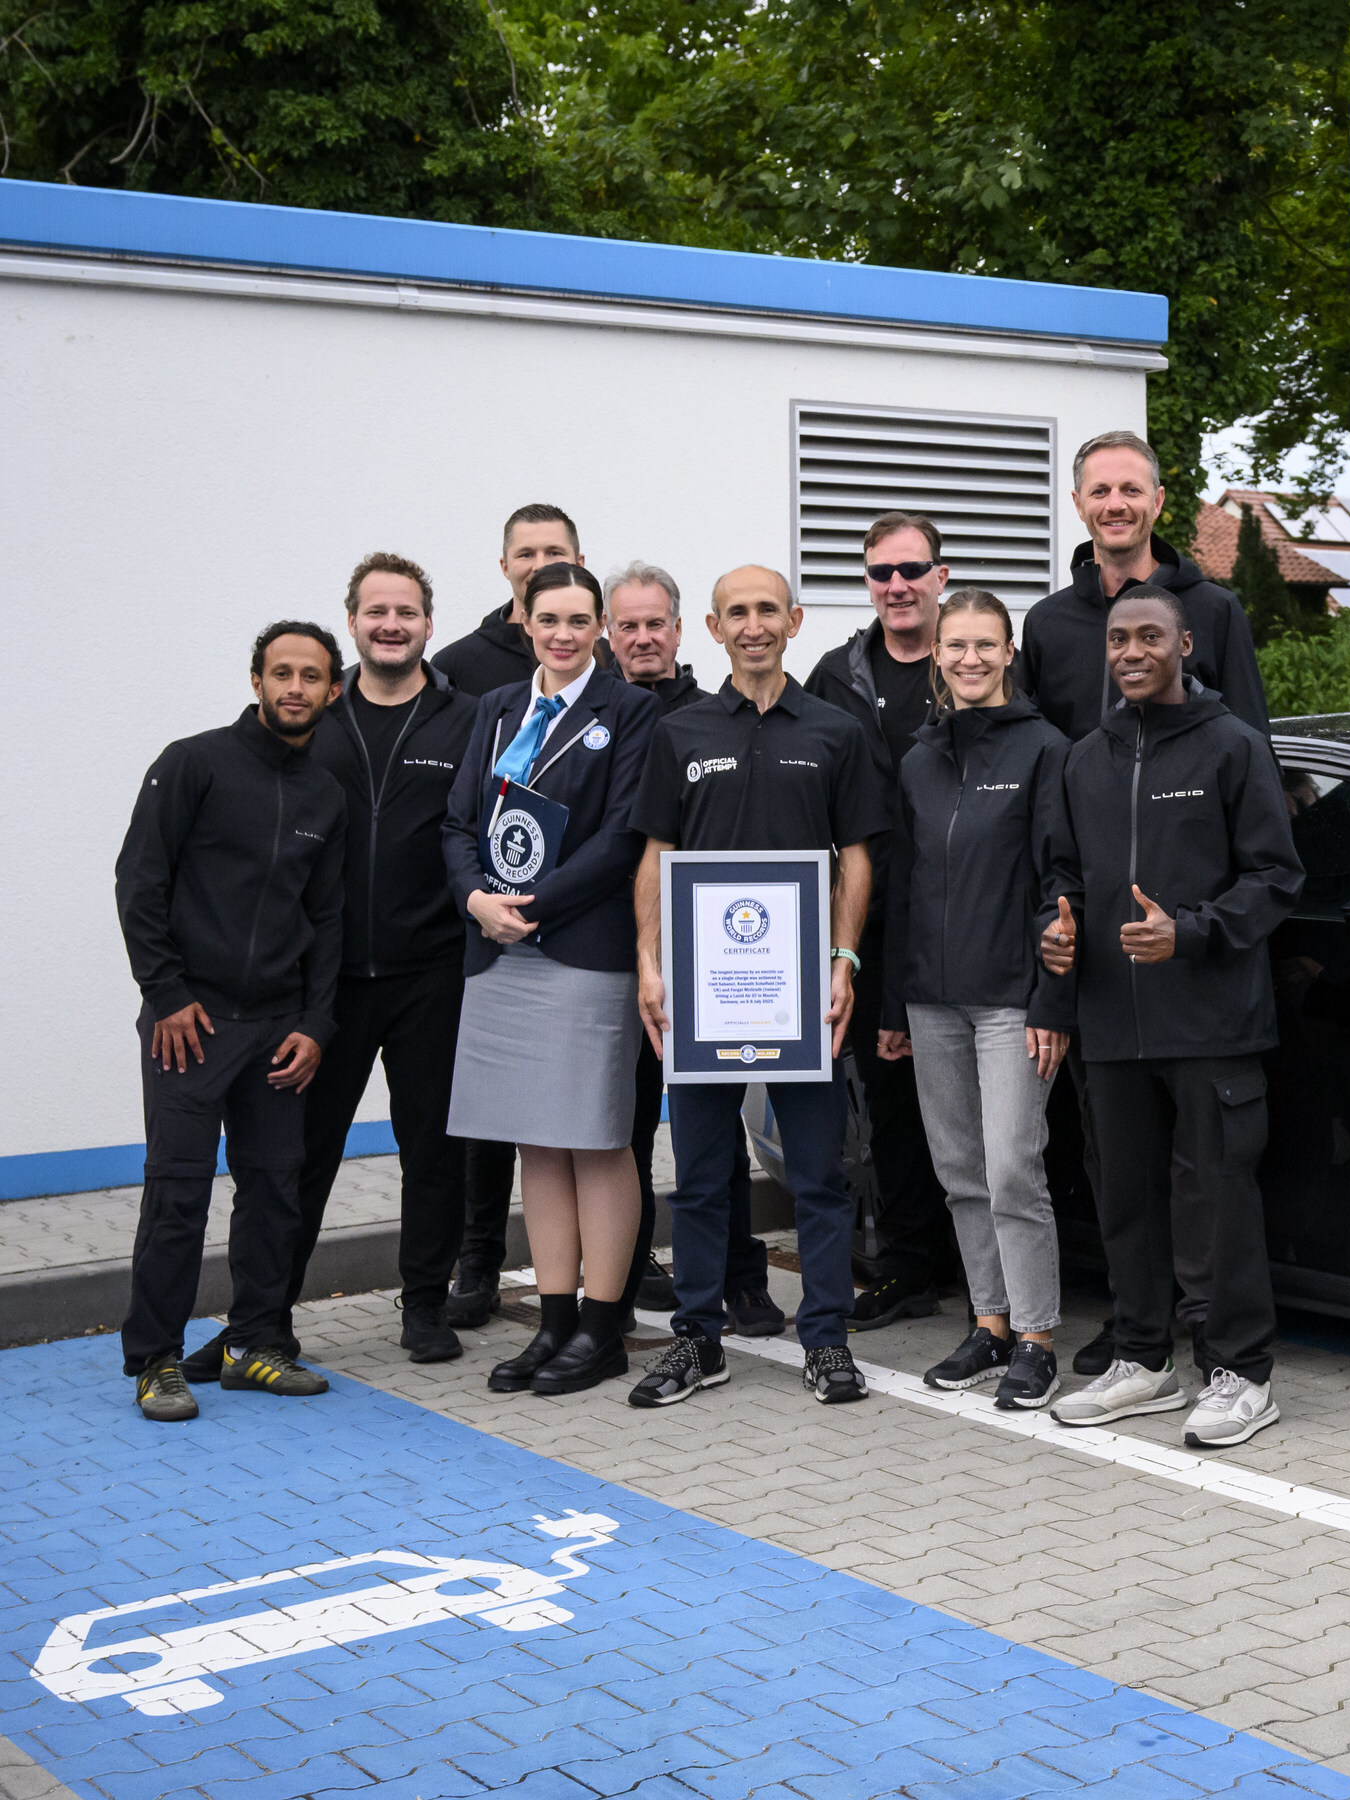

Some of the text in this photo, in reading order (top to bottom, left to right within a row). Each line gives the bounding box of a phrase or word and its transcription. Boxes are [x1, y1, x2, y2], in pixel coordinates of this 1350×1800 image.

[403, 758, 454, 770] LUCID
[702, 756, 738, 768] OFFICIAL
[779, 759, 819, 768] LUCID
[703, 763, 738, 775] ATTEMPT
[976, 783, 1020, 791] LUCID
[1151, 789, 1205, 800] LUCID
[502, 814, 540, 841] GUINNESS
[492, 833, 541, 878] WORLD RECORDS
[729, 900, 764, 914] GUINNESS
[725, 918, 768, 943] WORLD RECORDS
[723, 947, 771, 955] CERTIFICATE
